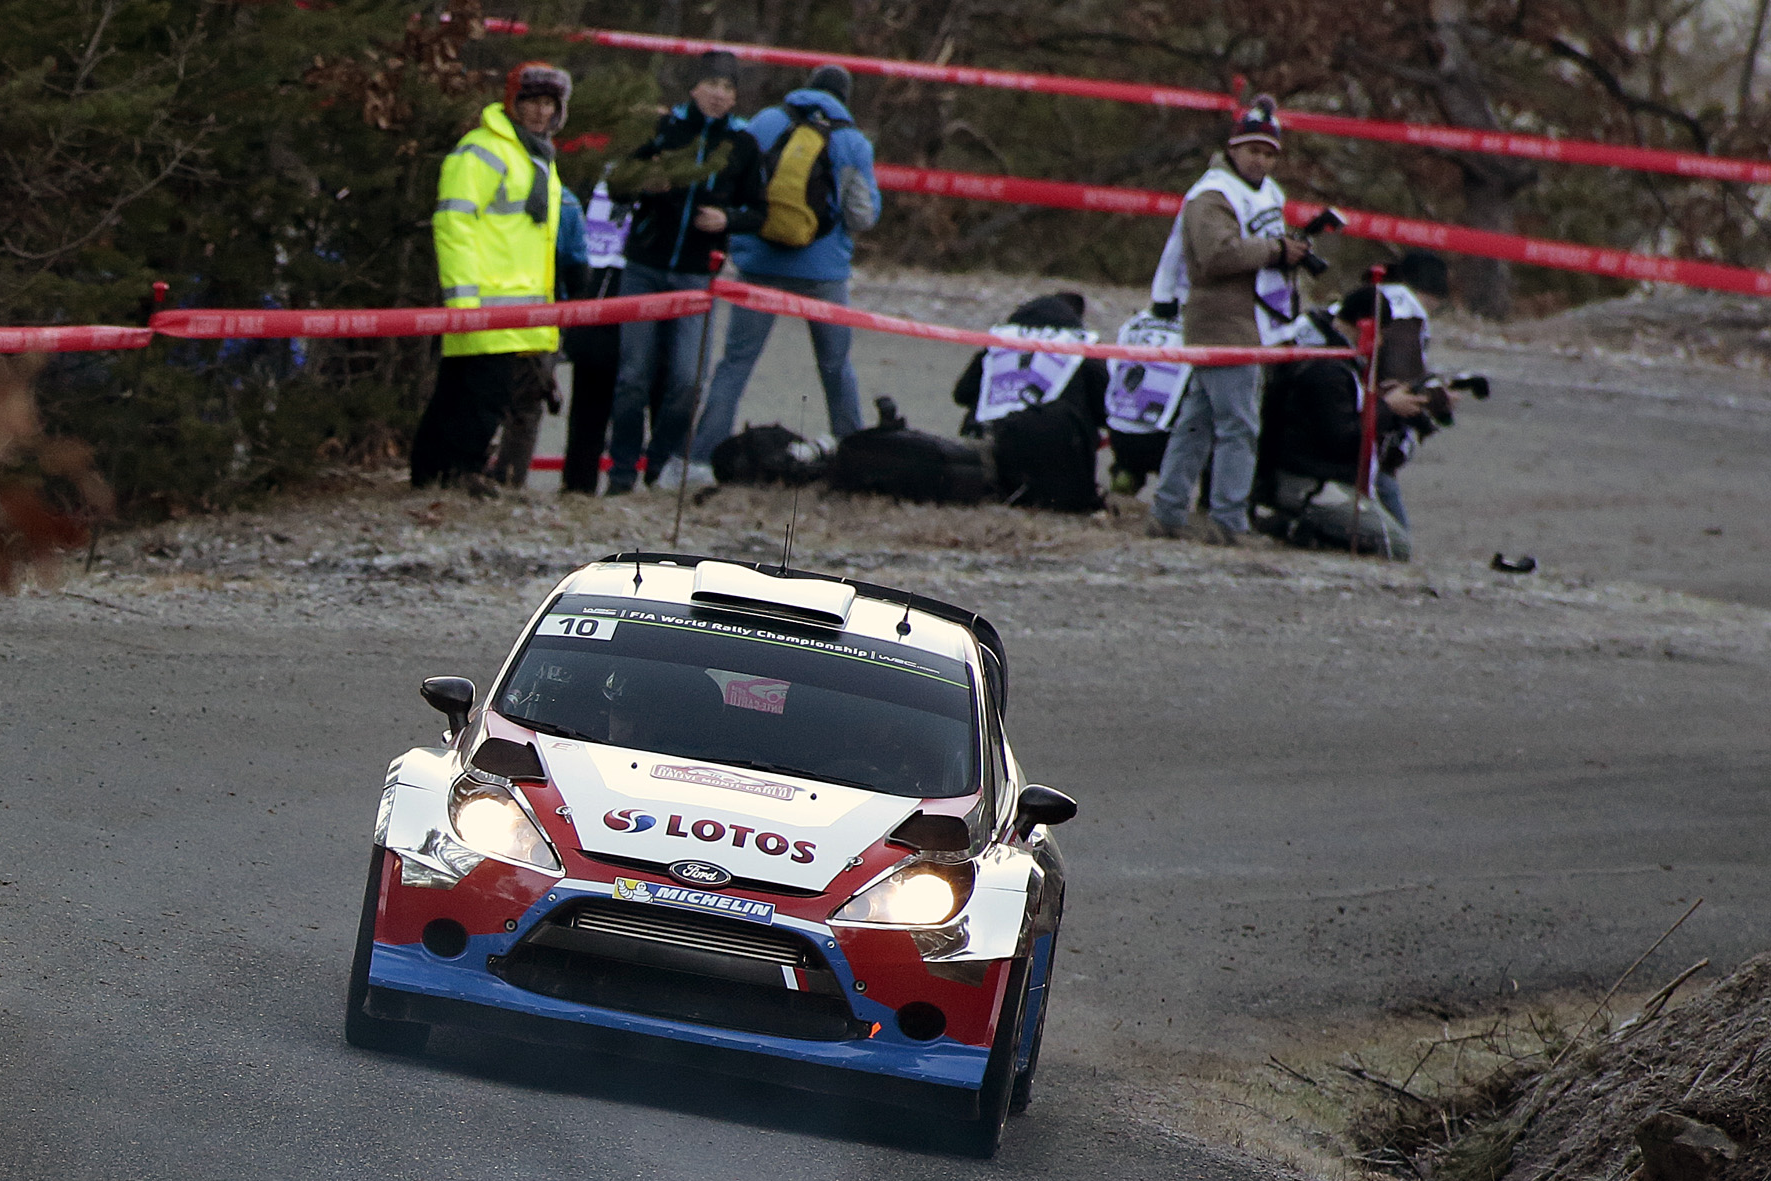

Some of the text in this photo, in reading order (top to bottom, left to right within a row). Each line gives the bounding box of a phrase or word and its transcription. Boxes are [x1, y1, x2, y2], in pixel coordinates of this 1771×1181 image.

[558, 617, 599, 636] 10
[629, 611, 656, 620] FIA
[661, 615, 707, 628] World
[711, 622, 752, 636] Rally
[756, 630, 868, 658] Championship
[666, 815, 817, 864] LOTOS
[682, 863, 719, 882] Ford
[656, 887, 771, 917] MICHELIN
